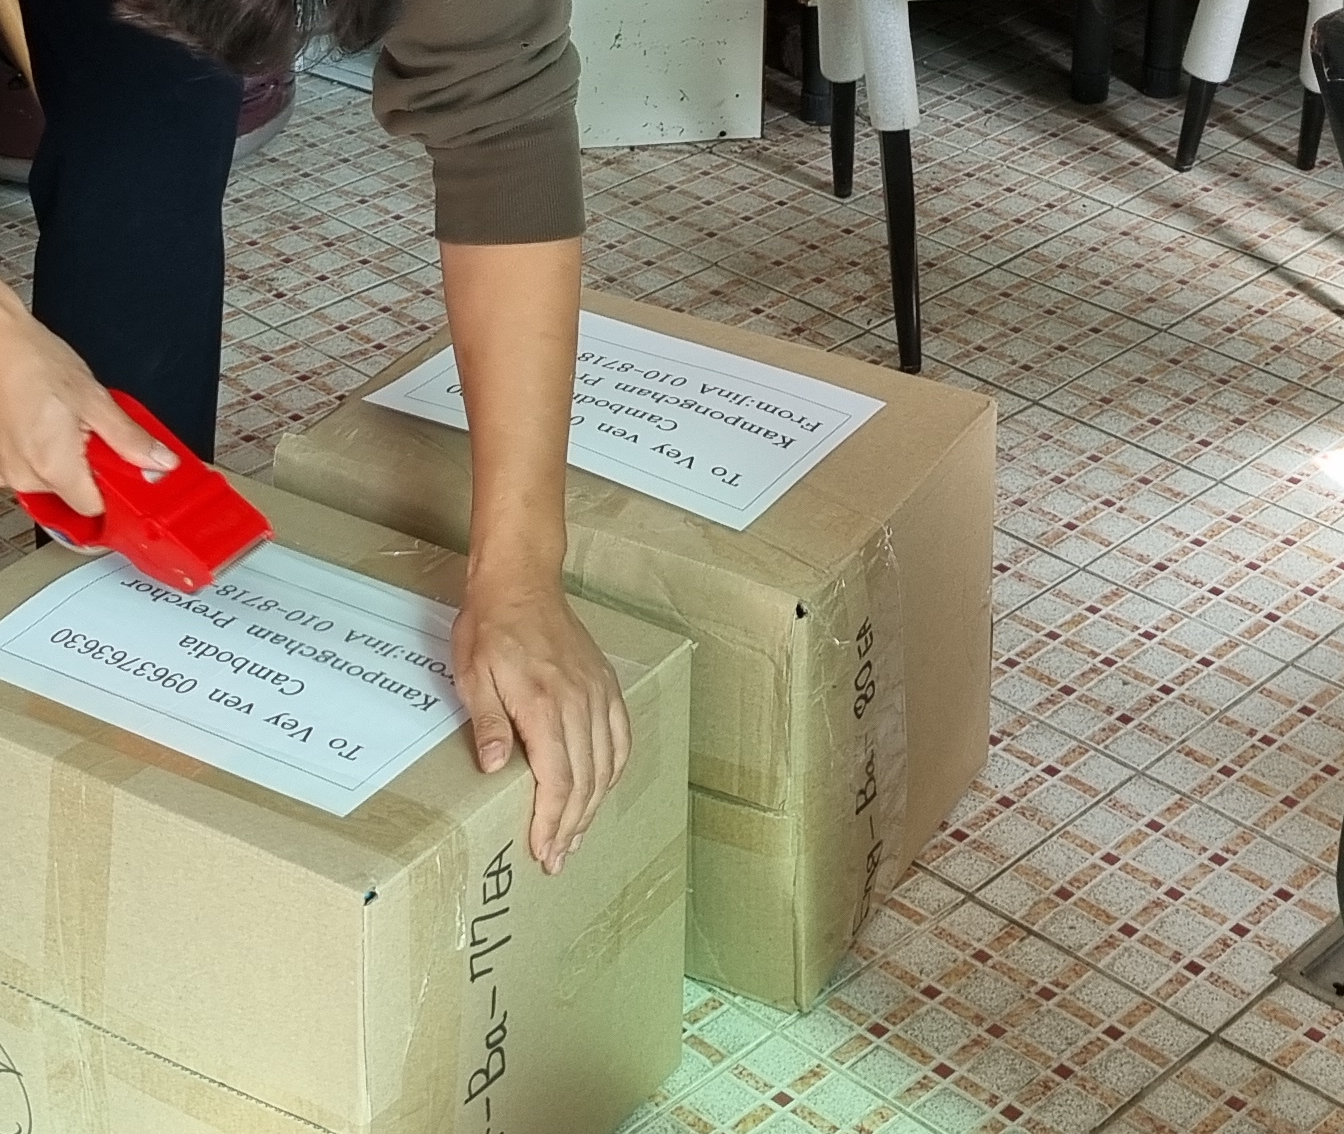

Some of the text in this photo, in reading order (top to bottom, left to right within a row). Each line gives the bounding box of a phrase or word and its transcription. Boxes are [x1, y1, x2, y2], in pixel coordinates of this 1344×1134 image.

[615, 382, 796, 449] Kampongcham
[597, 422, 742, 487] To Vey ven
[120, 577, 441, 712] Kampongcham Preychor
[177, 634, 305, 696] Cambodia
[343, 628, 456, 686] rom:JinA
[49, 627, 364, 761] To Vey ven 0963763630
